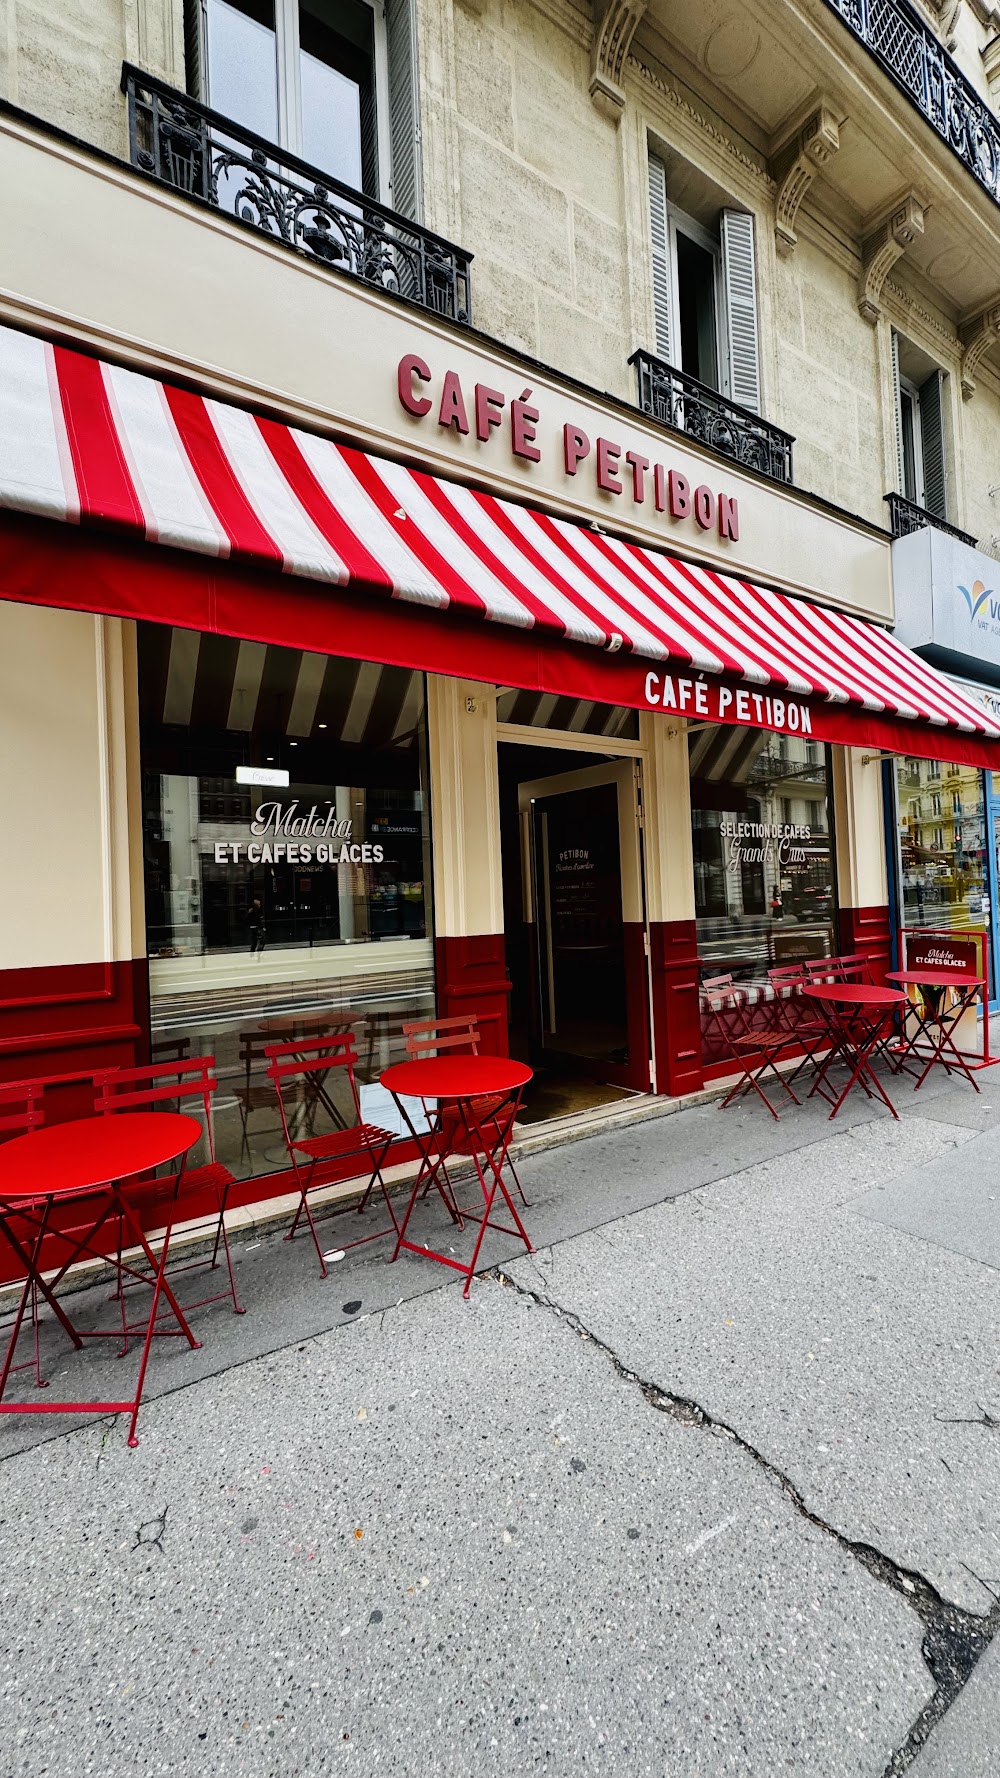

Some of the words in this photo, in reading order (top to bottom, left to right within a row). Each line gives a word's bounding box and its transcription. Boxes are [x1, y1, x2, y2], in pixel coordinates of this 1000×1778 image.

[397, 353, 541, 463] CAFÉ
[563, 423, 740, 543] PETIBON
[977, 619, 989, 631] VAT
[644, 671, 709, 715] CAFÉ
[718, 686, 812, 734] PETIBON
[250, 801, 353, 839] Matcha
[771, 823, 783, 838] DE
[214, 842, 243, 864] ET
[559, 848, 589, 861] PETIBON
[729, 836, 773, 873] Grands
[779, 837, 806, 865] Crus
[928, 949, 953, 959] Matcha
